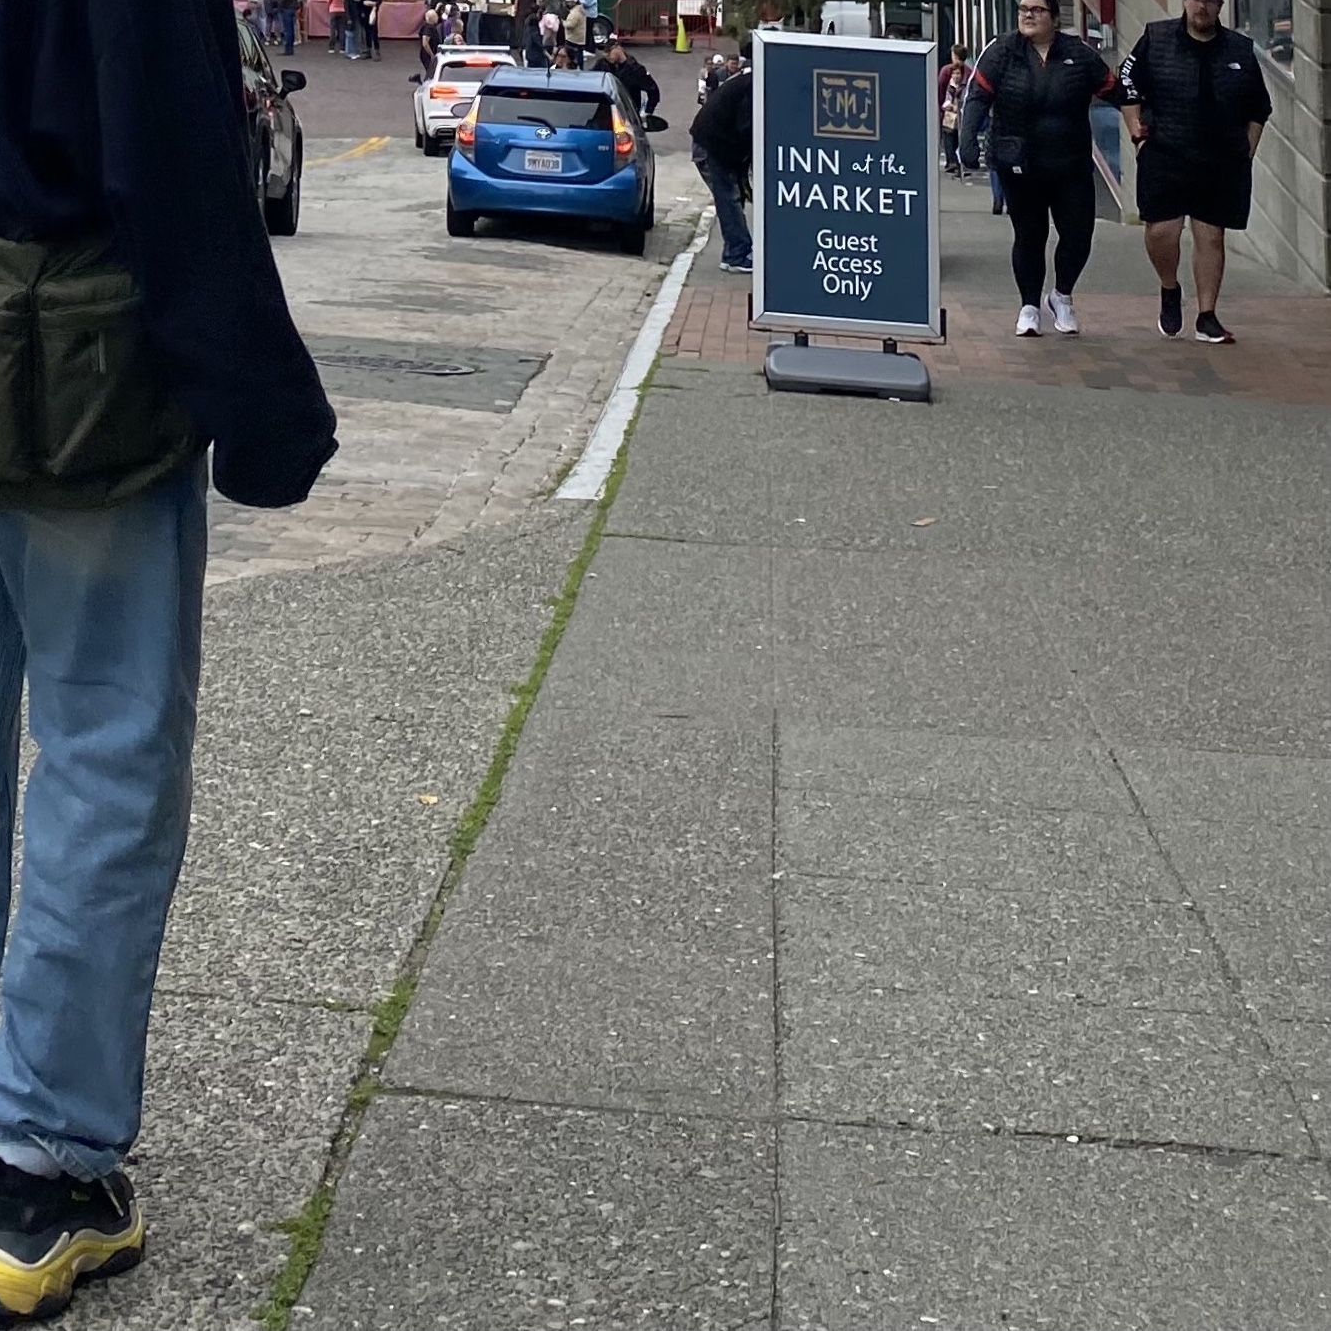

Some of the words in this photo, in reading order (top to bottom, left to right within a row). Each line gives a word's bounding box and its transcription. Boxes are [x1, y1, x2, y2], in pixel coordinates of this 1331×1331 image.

[777, 145, 840, 175] INN
[852, 155, 874, 175] at
[879, 153, 906, 176] the
[777, 180, 918, 216] MARKET
[817, 229, 878, 252] Guest
[812, 251, 882, 274] Access
[823, 274, 872, 301] Only
